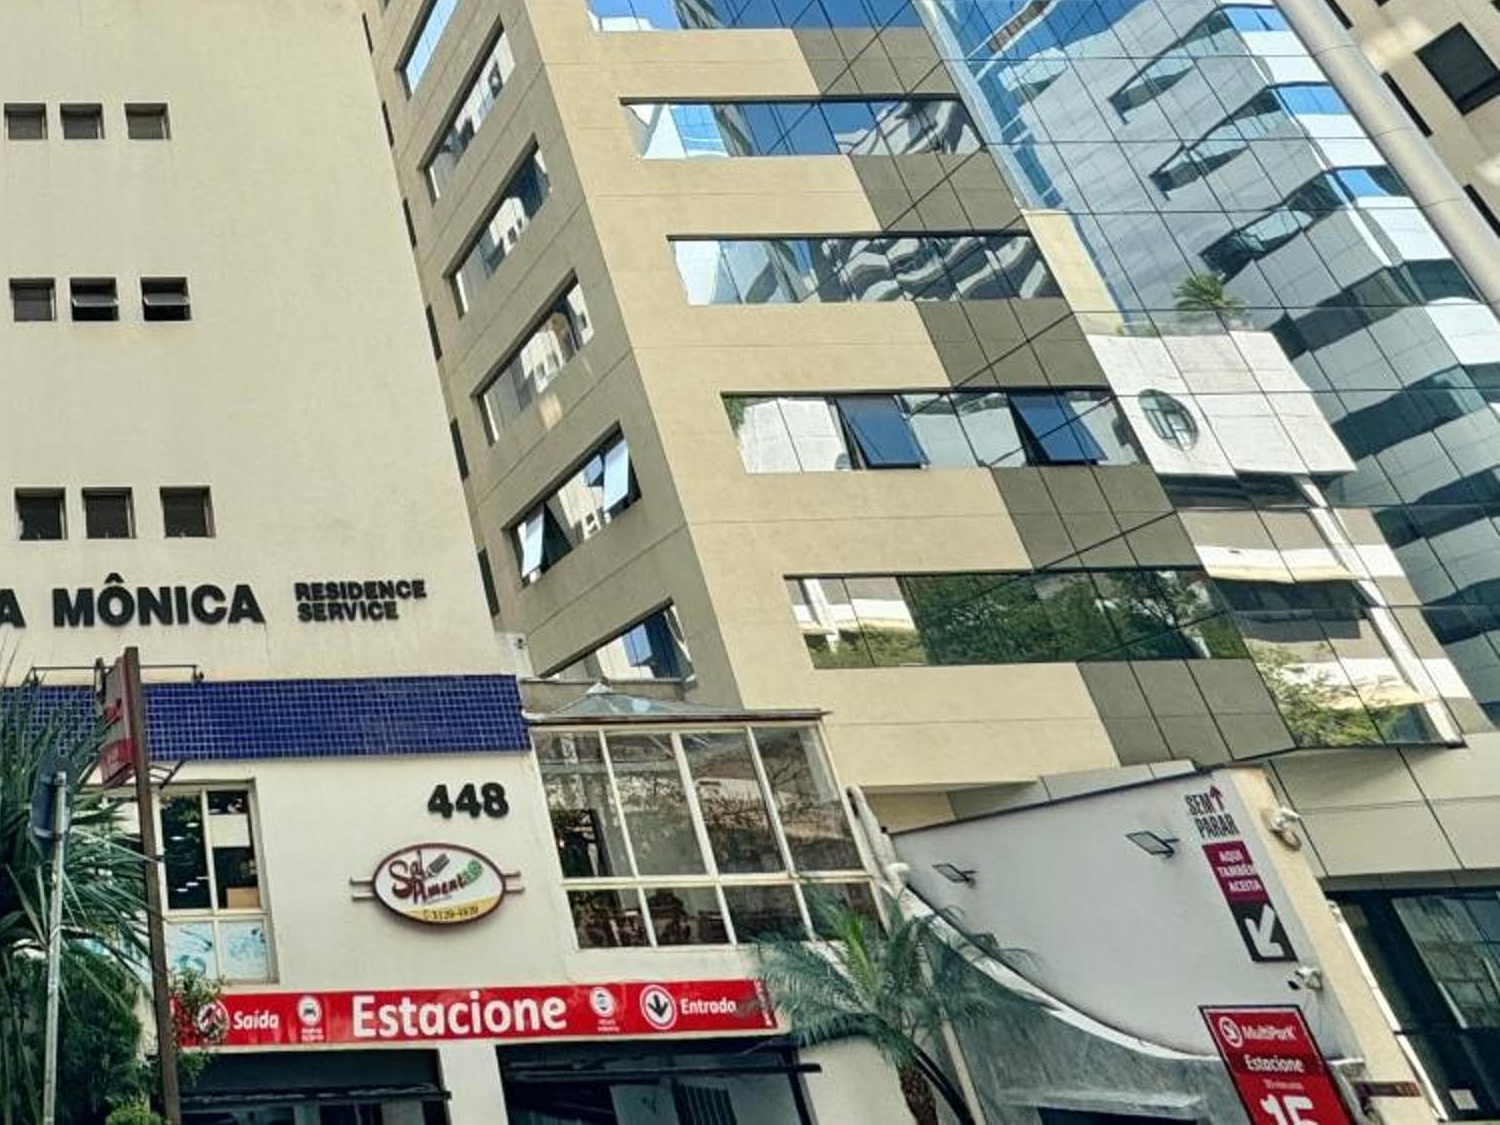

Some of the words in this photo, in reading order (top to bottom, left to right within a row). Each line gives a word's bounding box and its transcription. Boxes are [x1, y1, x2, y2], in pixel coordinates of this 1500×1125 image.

[52, 572, 266, 628] MÔNICA
[294, 579, 427, 602] RESIDENCE
[297, 600, 400, 623] SERVICE
[427, 781, 510, 819] 448
[1184, 792, 1217, 816] SEM
[1194, 813, 1241, 838] PARAR
[353, 989, 568, 1039] Estacione
[680, 997, 737, 1015] Entrada
[1244, 1054, 1305, 1073] Estacione
